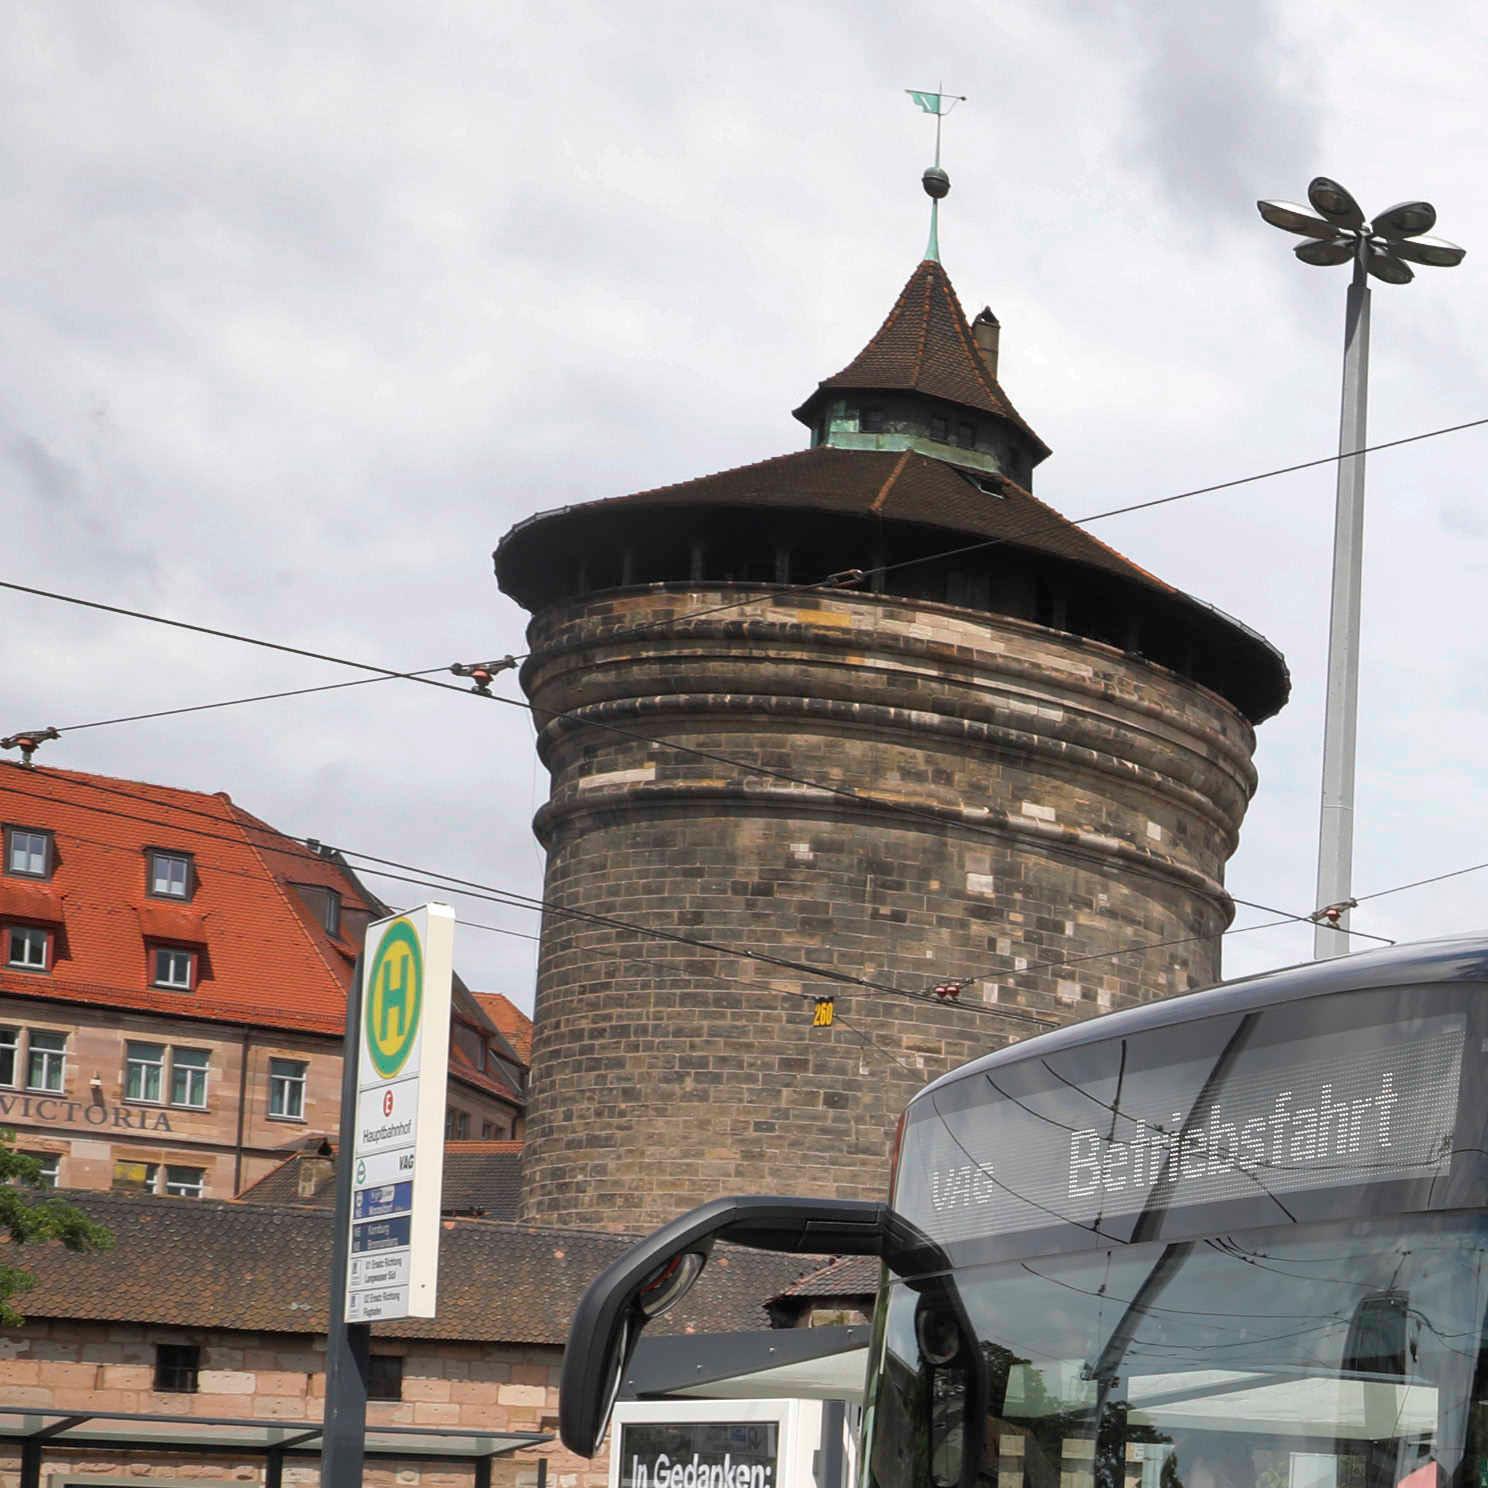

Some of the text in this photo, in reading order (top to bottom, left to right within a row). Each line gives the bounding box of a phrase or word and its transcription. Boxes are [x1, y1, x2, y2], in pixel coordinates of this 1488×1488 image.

[379, 954, 409, 1042] H
[0, 1095, 174, 1132] VICTORIA
[362, 1120, 412, 1144] Hauptbahnhof
[1067, 1071, 1399, 1200] Betriebsfahrt
[399, 1154, 415, 1170] VAG
